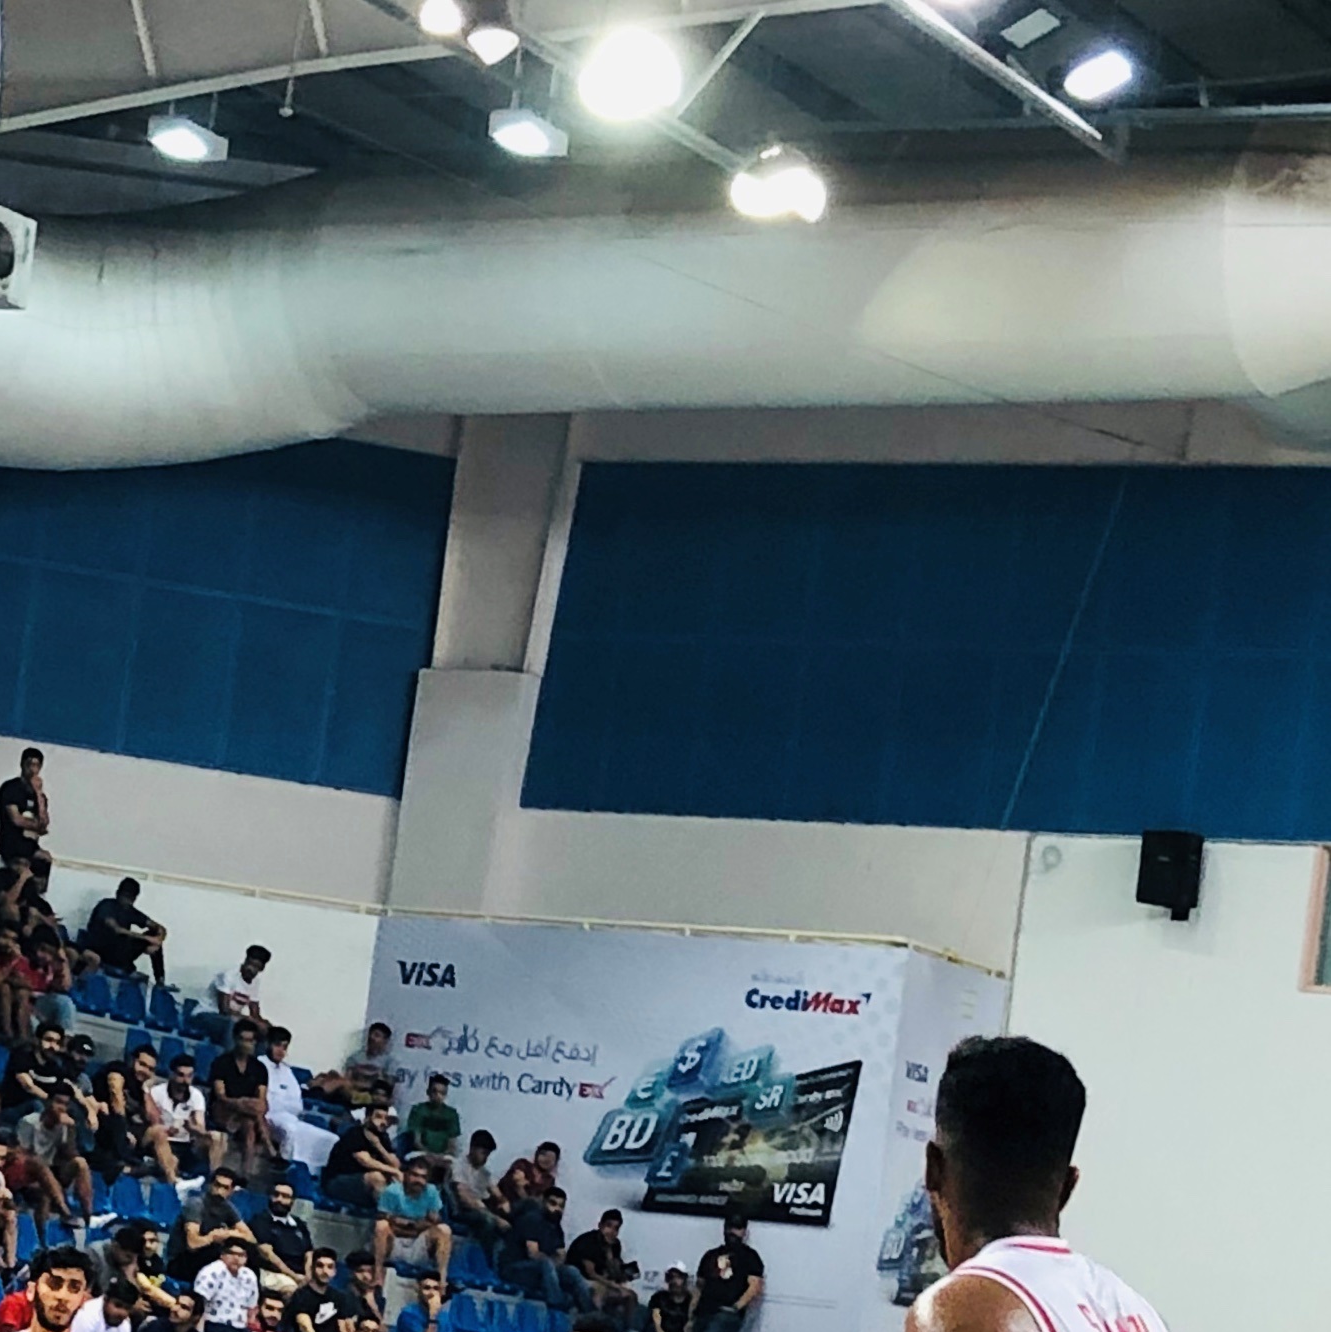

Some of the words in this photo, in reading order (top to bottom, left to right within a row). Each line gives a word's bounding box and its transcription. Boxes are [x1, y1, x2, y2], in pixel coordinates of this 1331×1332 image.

[397, 960, 456, 988] VISA
[744, 987, 862, 1015] CrediMax
[394, 1066, 418, 1089] ay
[424, 1065, 463, 1089] ls
[469, 1070, 510, 1091] with
[754, 1084, 785, 1111] SR
[600, 1111, 659, 1151] BD
[772, 1182, 826, 1205] VISA
